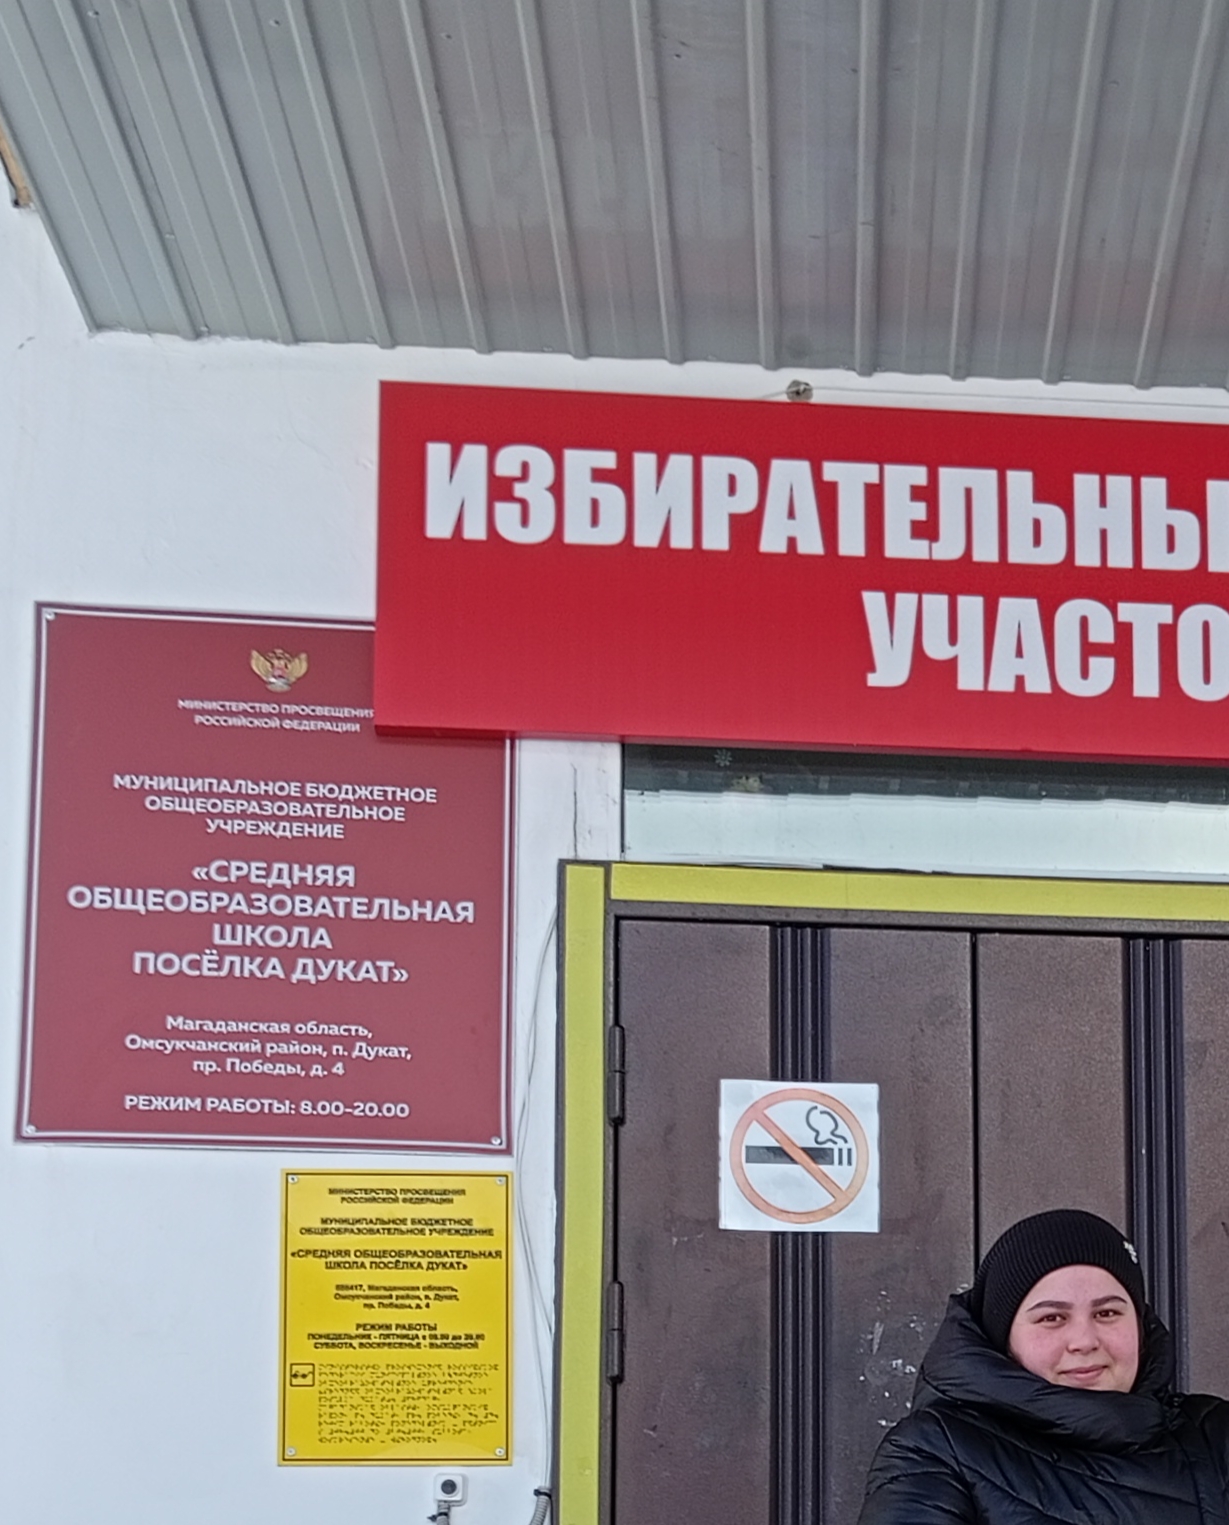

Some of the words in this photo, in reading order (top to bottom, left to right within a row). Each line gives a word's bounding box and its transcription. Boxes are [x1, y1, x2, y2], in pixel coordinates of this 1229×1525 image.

[178, 699, 280, 714] МИНИСТЕРСТВО
[194, 714, 280, 728] РОССИЙСКОЙ
[282, 720, 360, 733] ФЕДЕРАЦИИ
[113, 774, 301, 797] МУНИЦИПАЛЬНОЕ
[305, 782, 437, 803] БЮДЖЕТНОЕ
[144, 795, 405, 821] ОБЩЕОБРАЗОВАТЕЛЬНОЕ
[206, 819, 344, 839] УЧРЕЖДЕНИЕ
[192, 859, 355, 887] «СРЕДНЯЯ
[67, 885, 474, 923] ОБЩЕОБРАЗОВАТЕЛЬНАЯ
[212, 923, 332, 948] ШКОЛА
[133, 949, 285, 980] ПОСЁЛКА
[291, 960, 409, 984] ДУКАТ»
[166, 1015, 290, 1035] Магаданская
[295, 1019, 373, 1039] область,
[125, 1034, 262, 1056] Омсукчанский
[266, 1038, 327, 1057] район,
[332, 1044, 348, 1055] п.
[352, 1042, 412, 1060] Дукат,
[193, 1060, 221, 1076] пр.
[225, 1058, 306, 1077] Победы,
[310, 1064, 327, 1077] д.
[332, 1062, 345, 1075] 4
[124, 1095, 201, 1112] РЕЖИМ
[206, 1097, 296, 1115] РАБОТЫ:
[300, 1100, 409, 1118] 8.00-20.00
[299, 1227, 426, 1236] ОБЩЕОБРАЗОВАТЕЛЬНОЕ
[428, 1228, 494, 1237] УЧРЕЖДЕНИЕ
[320, 1218, 408, 1227] МУНИЦИПАЛЬНОЕ
[410, 1218, 473, 1227] БЮДЖЕТНОЕ
[290, 1249, 351, 1259] «СРЕДНЯЯ
[353, 1249, 502, 1259] ОБЩЕОБРАЗОВАТЕЛЬНАЯ
[325, 1260, 366, 1270] ШКОЛА
[369, 1259, 424, 1270] ПОСЁЛКА
[426, 1261, 468, 1271] ДУКАТ»
[355, 1323, 392, 1331] РЕЖИМ
[395, 1323, 437, 1331] РАБОТЫ
